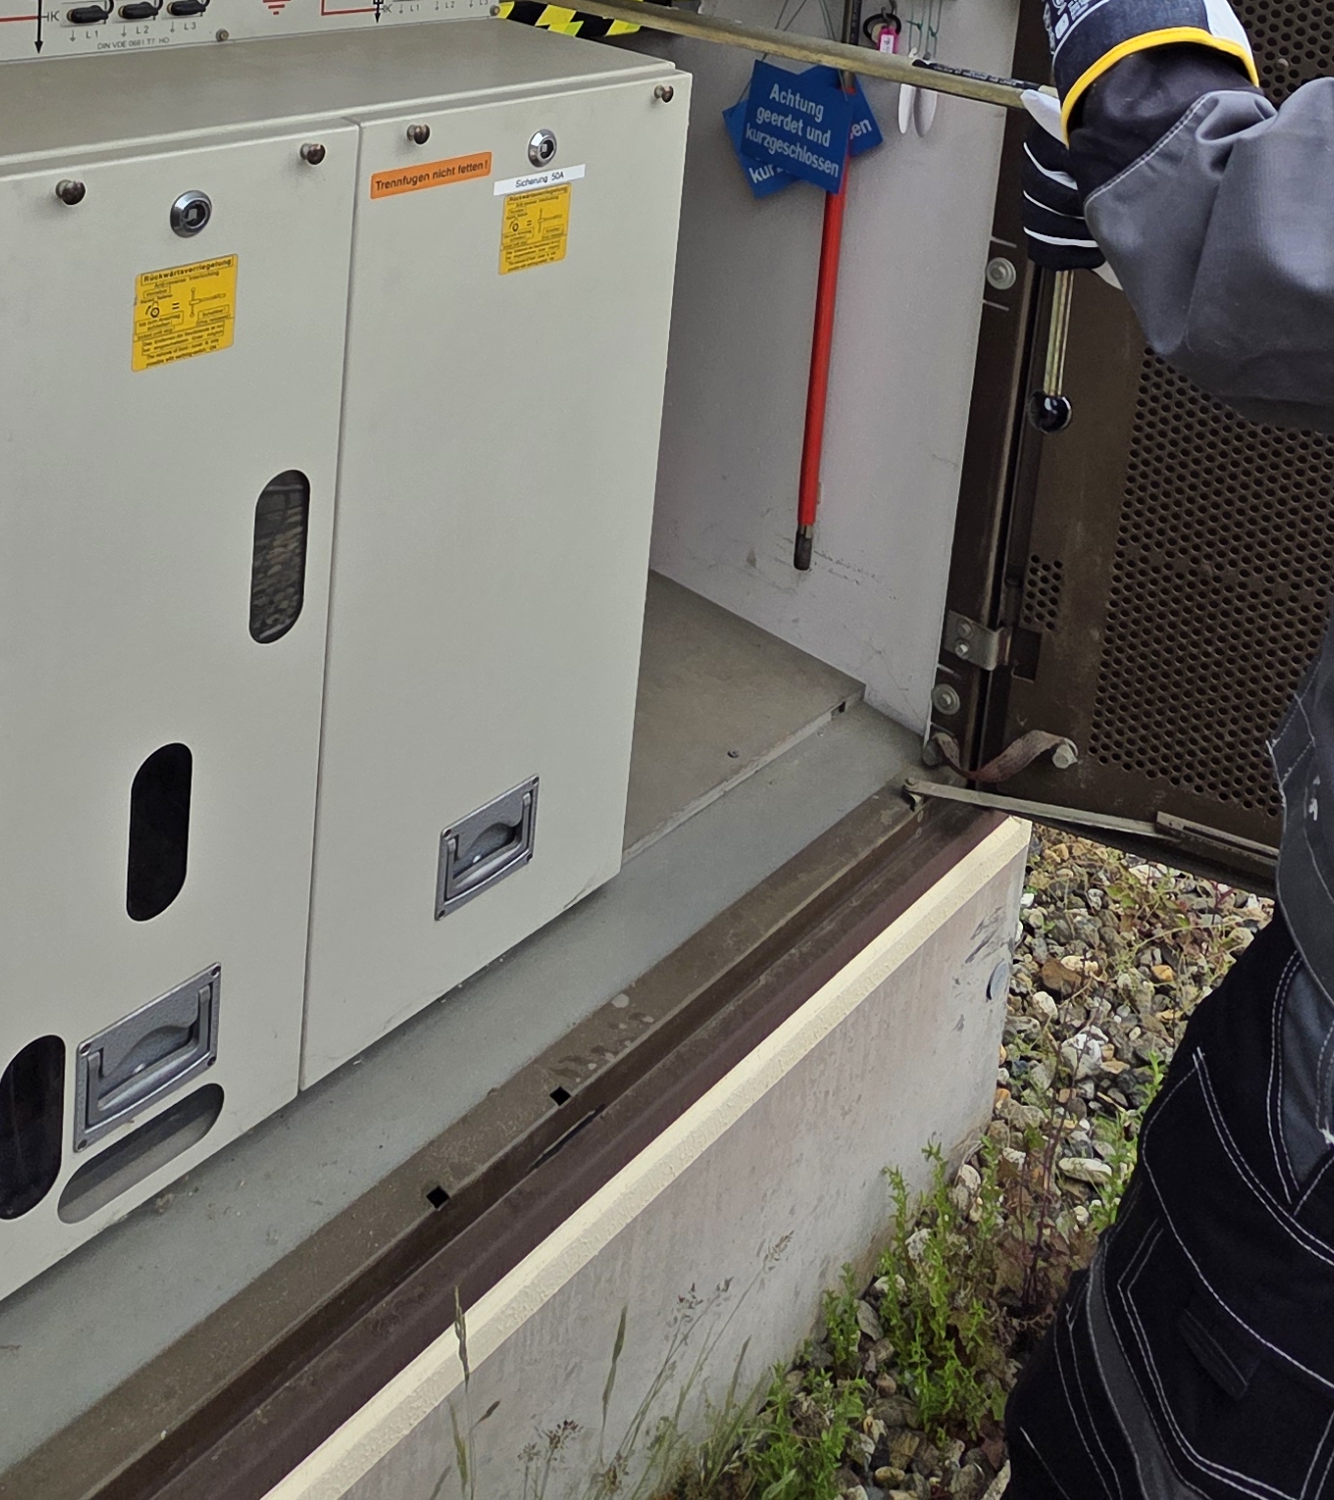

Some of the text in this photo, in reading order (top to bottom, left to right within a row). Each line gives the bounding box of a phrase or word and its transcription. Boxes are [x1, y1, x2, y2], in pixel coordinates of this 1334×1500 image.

[769, 83, 824, 123] Achtung
[756, 106, 831, 148] geerdet und
[745, 122, 839, 178] kurzgeschlossen
[376, 173, 430, 191] Trennfugen
[432, 167, 456, 180] nicht
[515, 171, 564, 188] Sicherung 50A
